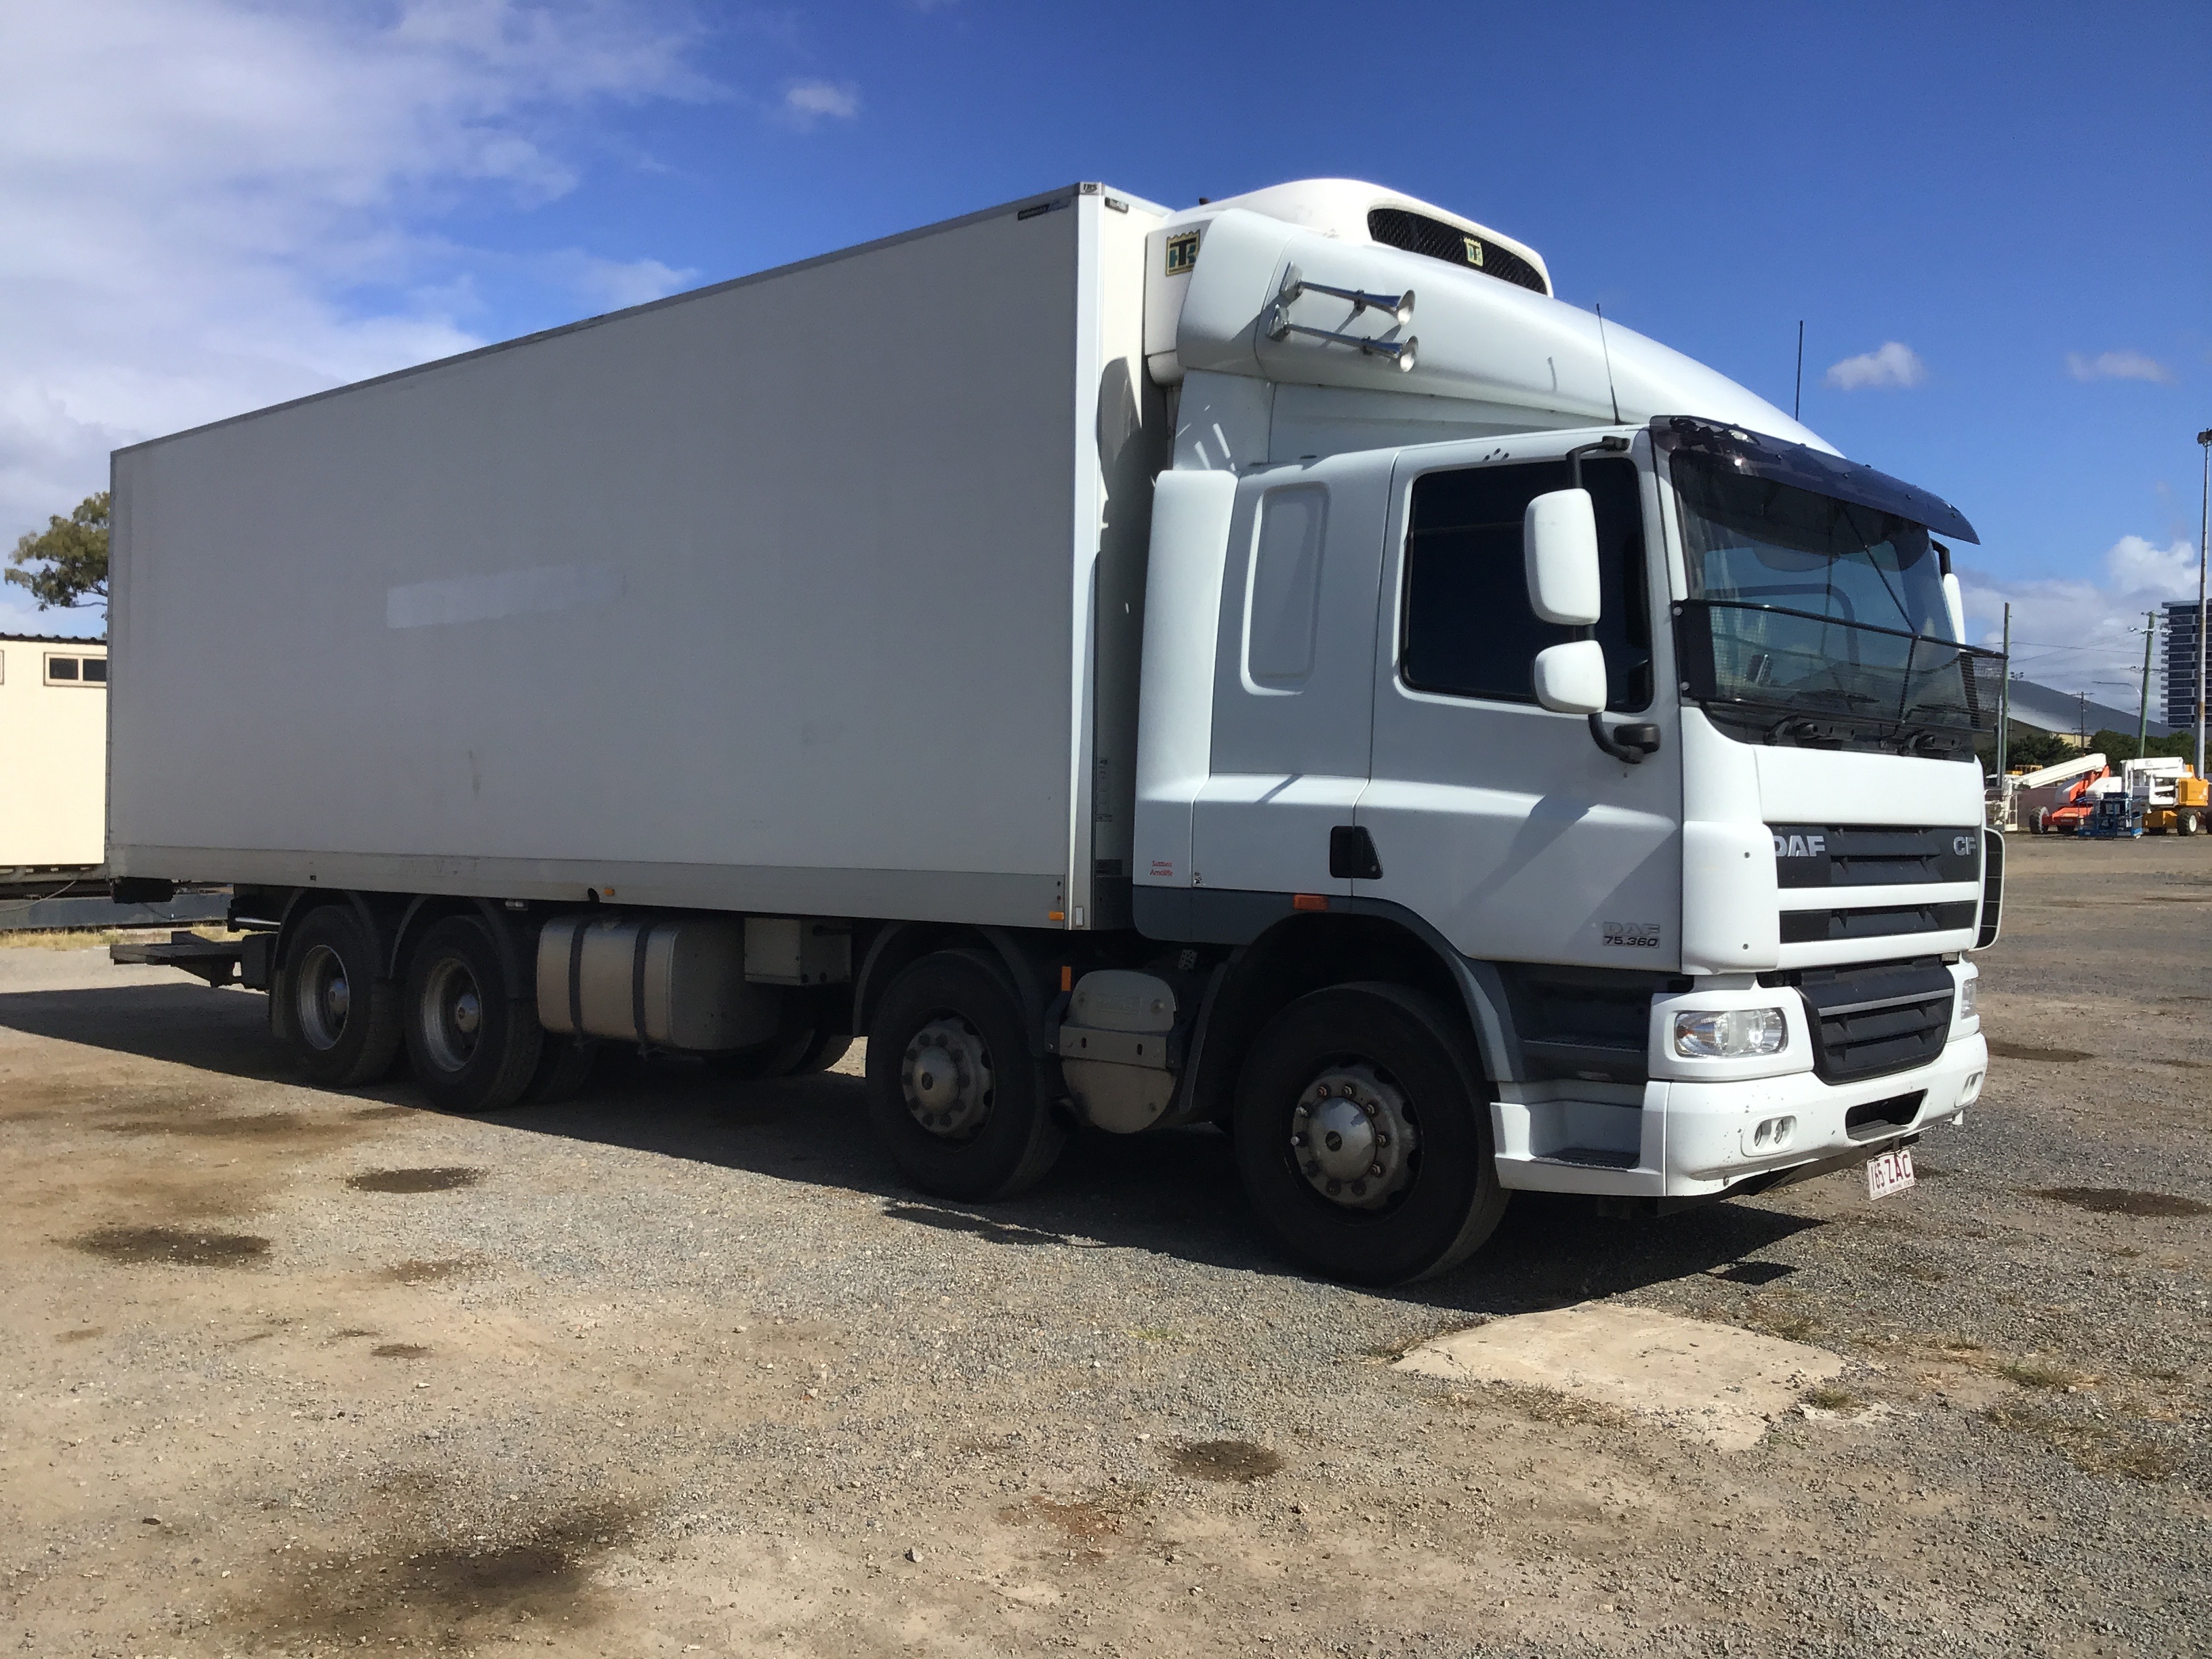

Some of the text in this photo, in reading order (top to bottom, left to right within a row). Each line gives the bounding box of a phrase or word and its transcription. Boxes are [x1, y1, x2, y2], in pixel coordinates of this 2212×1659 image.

[1774, 835, 1825, 857] DAF
[1953, 836, 1976, 856] CF
[1602, 922, 1660, 935] DAF
[1603, 936, 1658, 947] 75.360
